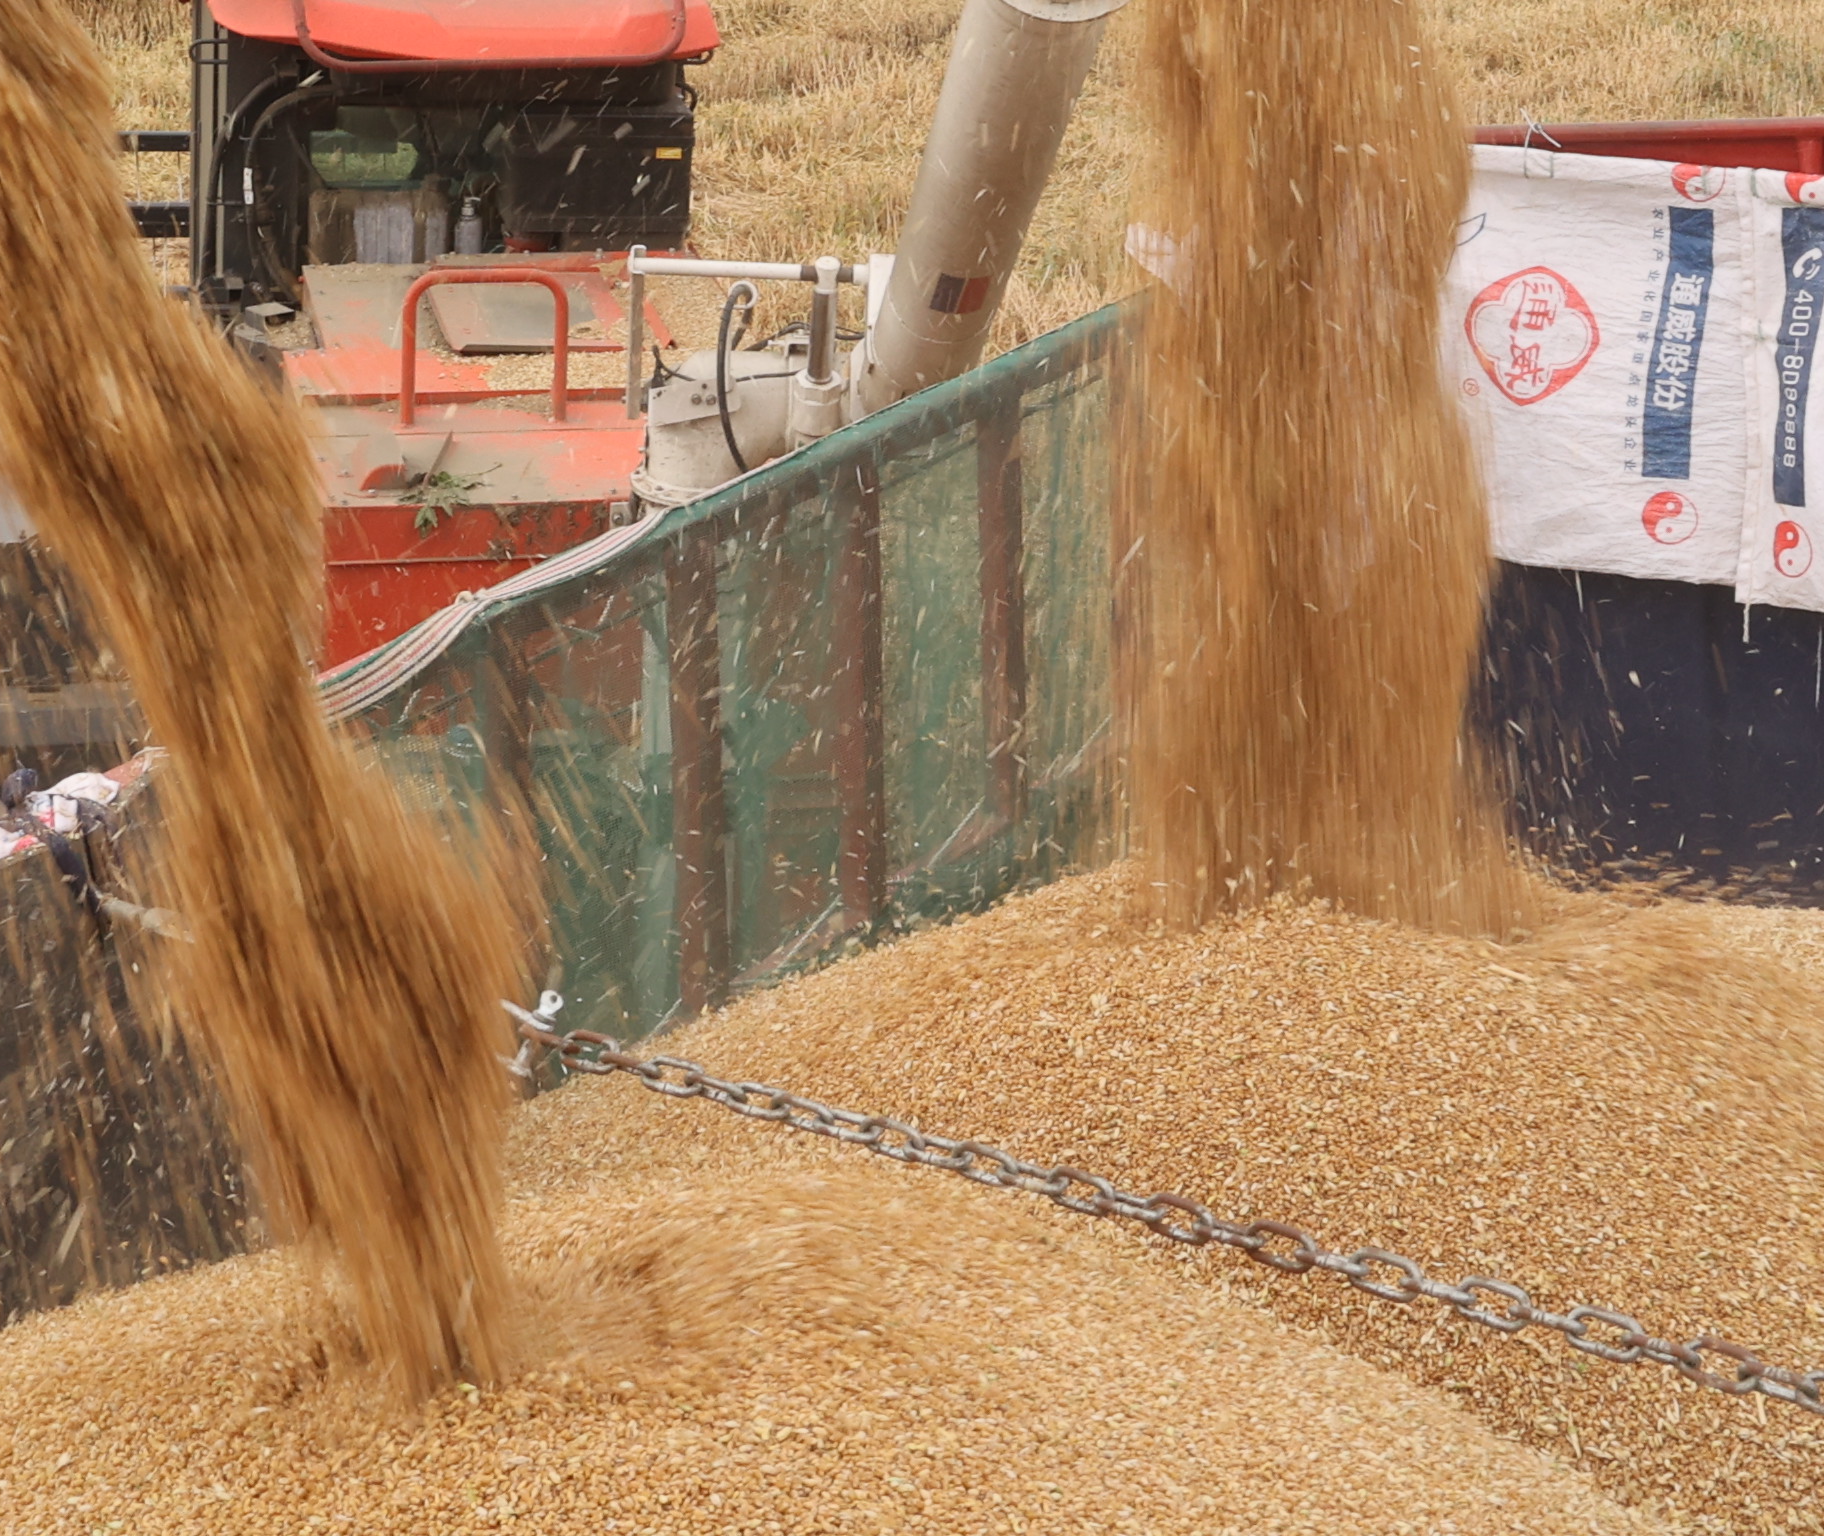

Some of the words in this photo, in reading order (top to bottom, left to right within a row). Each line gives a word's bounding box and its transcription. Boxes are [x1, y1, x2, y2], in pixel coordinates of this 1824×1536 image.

[1653, 272, 1705, 411] 通威股份
[1782, 289, 1814, 468] 400-8080888
